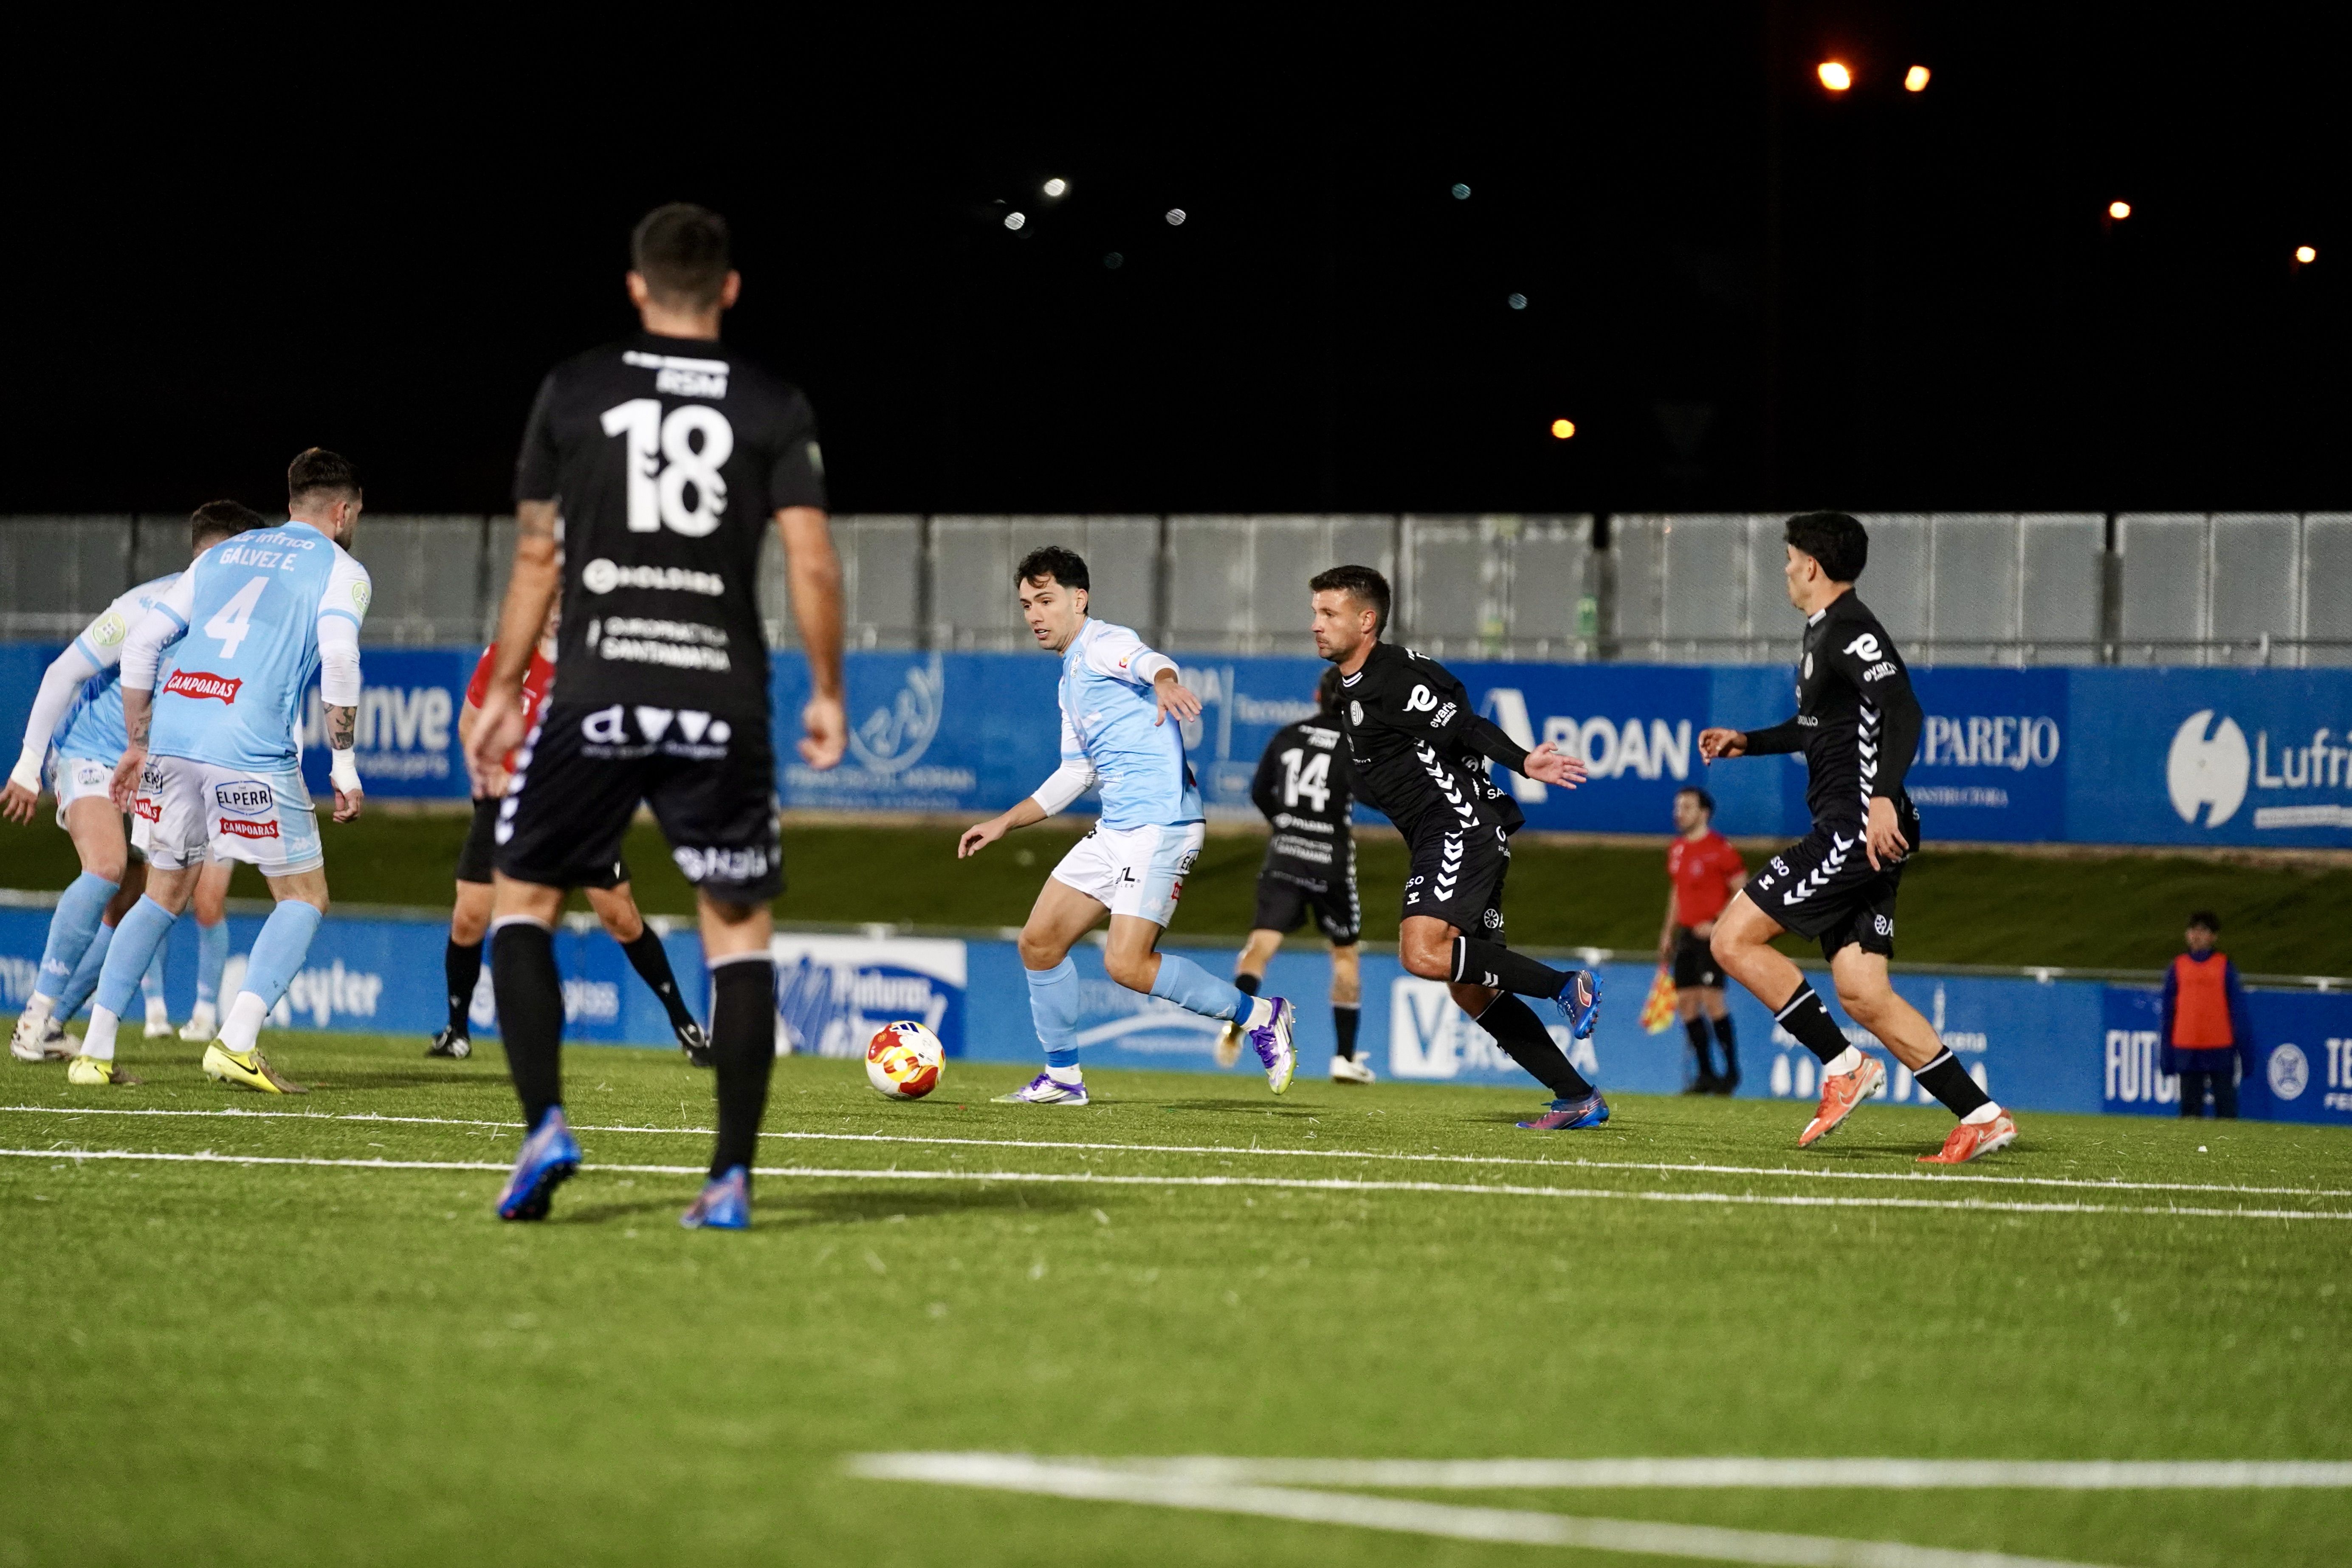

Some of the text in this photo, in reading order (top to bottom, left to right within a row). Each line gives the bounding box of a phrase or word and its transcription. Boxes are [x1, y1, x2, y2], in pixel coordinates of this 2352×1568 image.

[600, 398, 734, 538] 18
[219, 544, 297, 571] GÁLVEZ E.
[256, 532, 315, 550] Infrico
[204, 576, 269, 659] 4
[168, 675, 234, 697] CAMPOARAS
[1430, 702, 1457, 728] evaria
[1543, 715, 1692, 780] ROAN
[1925, 715, 2060, 771] PAREJO
[1280, 747, 1331, 812] 14
[223, 822, 275, 835] CAMPOARAS
